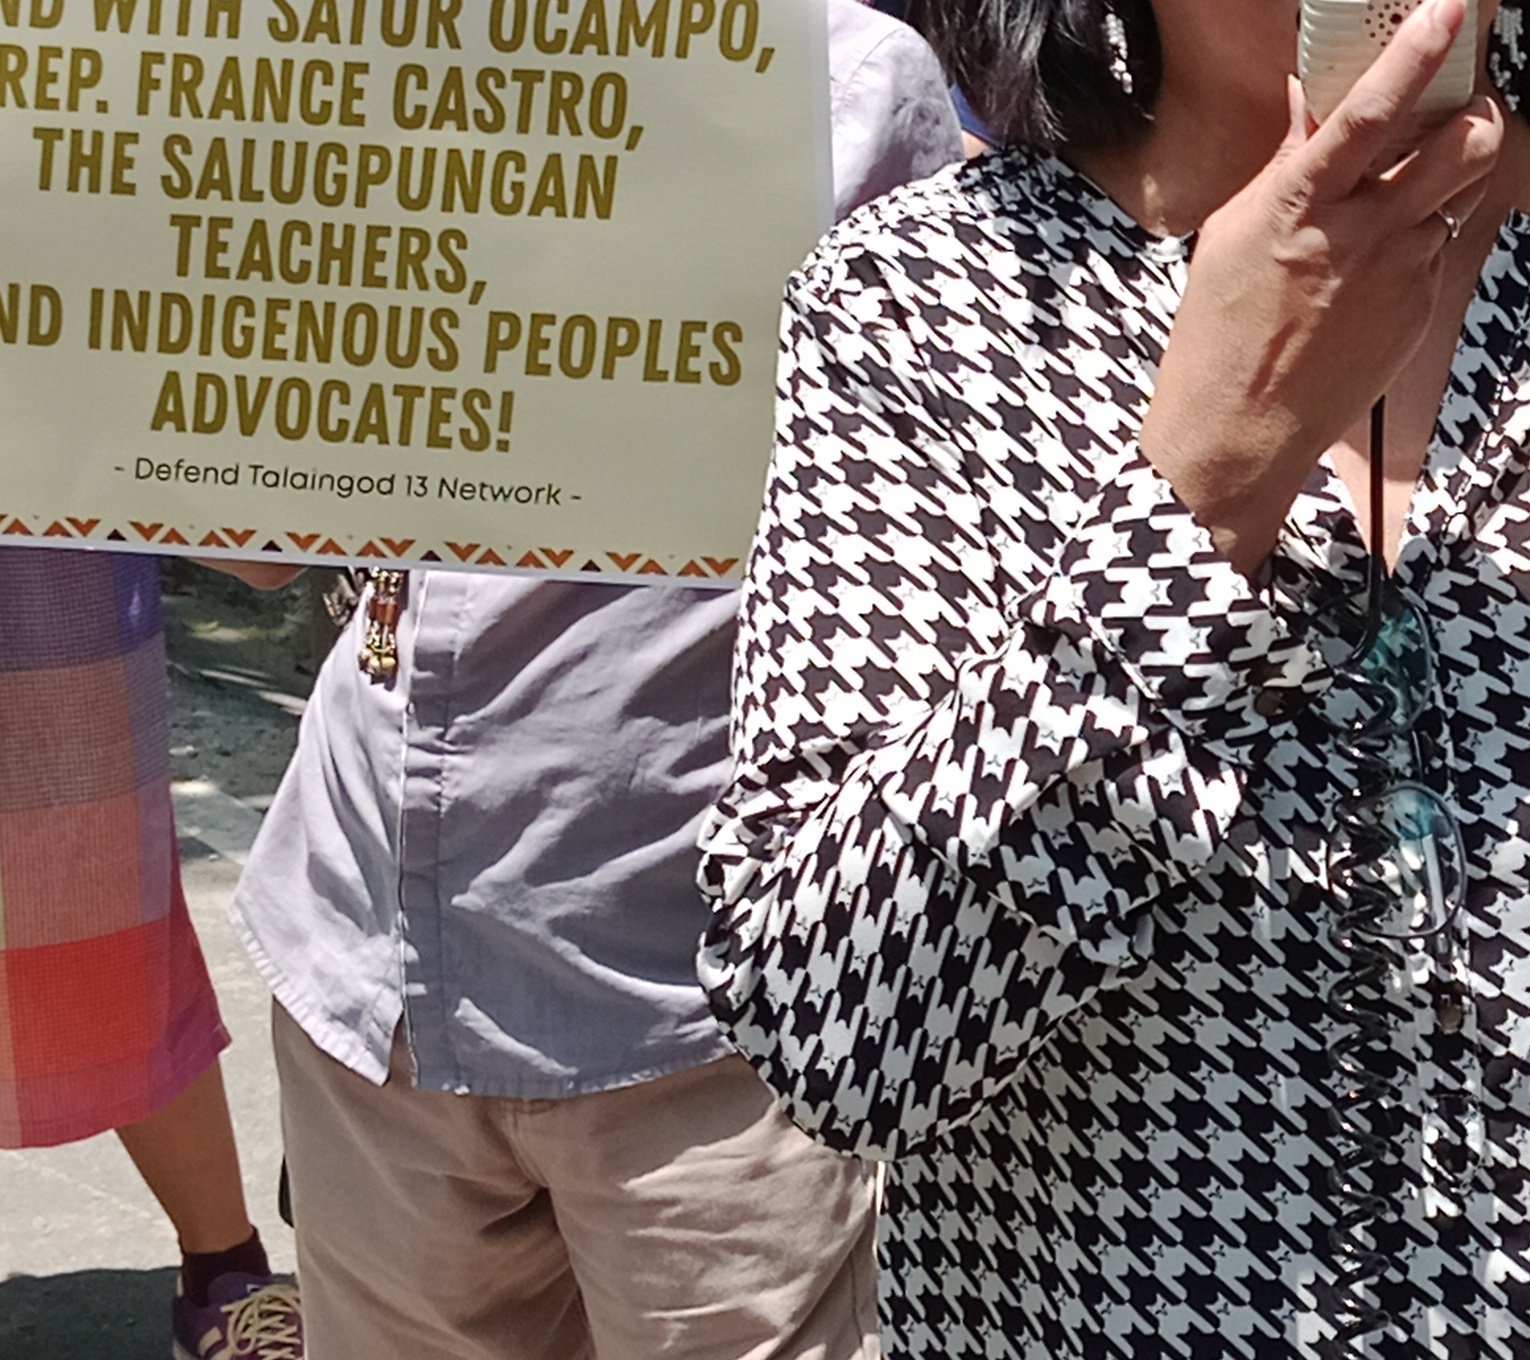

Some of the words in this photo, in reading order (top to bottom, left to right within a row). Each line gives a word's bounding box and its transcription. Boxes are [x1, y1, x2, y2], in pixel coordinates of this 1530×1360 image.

[0, 44, 108, 114] REP.
[136, 51, 370, 127] FRANCE
[393, 63, 644, 151] CASTRO,
[33, 127, 140, 196] THE
[160, 133, 618, 220] SALUGPUNGAN
[169, 213, 487, 306] TEACHERS,
[88, 288, 460, 373] INDIGENOUS
[483, 310, 743, 387] PEOPLES
[150, 370, 515, 453] ADVOCATES!
[134, 456, 240, 486] Defend
[247, 464, 396, 499] Talaingod
[405, 474, 429, 498] 13
[437, 476, 562, 506] Network
